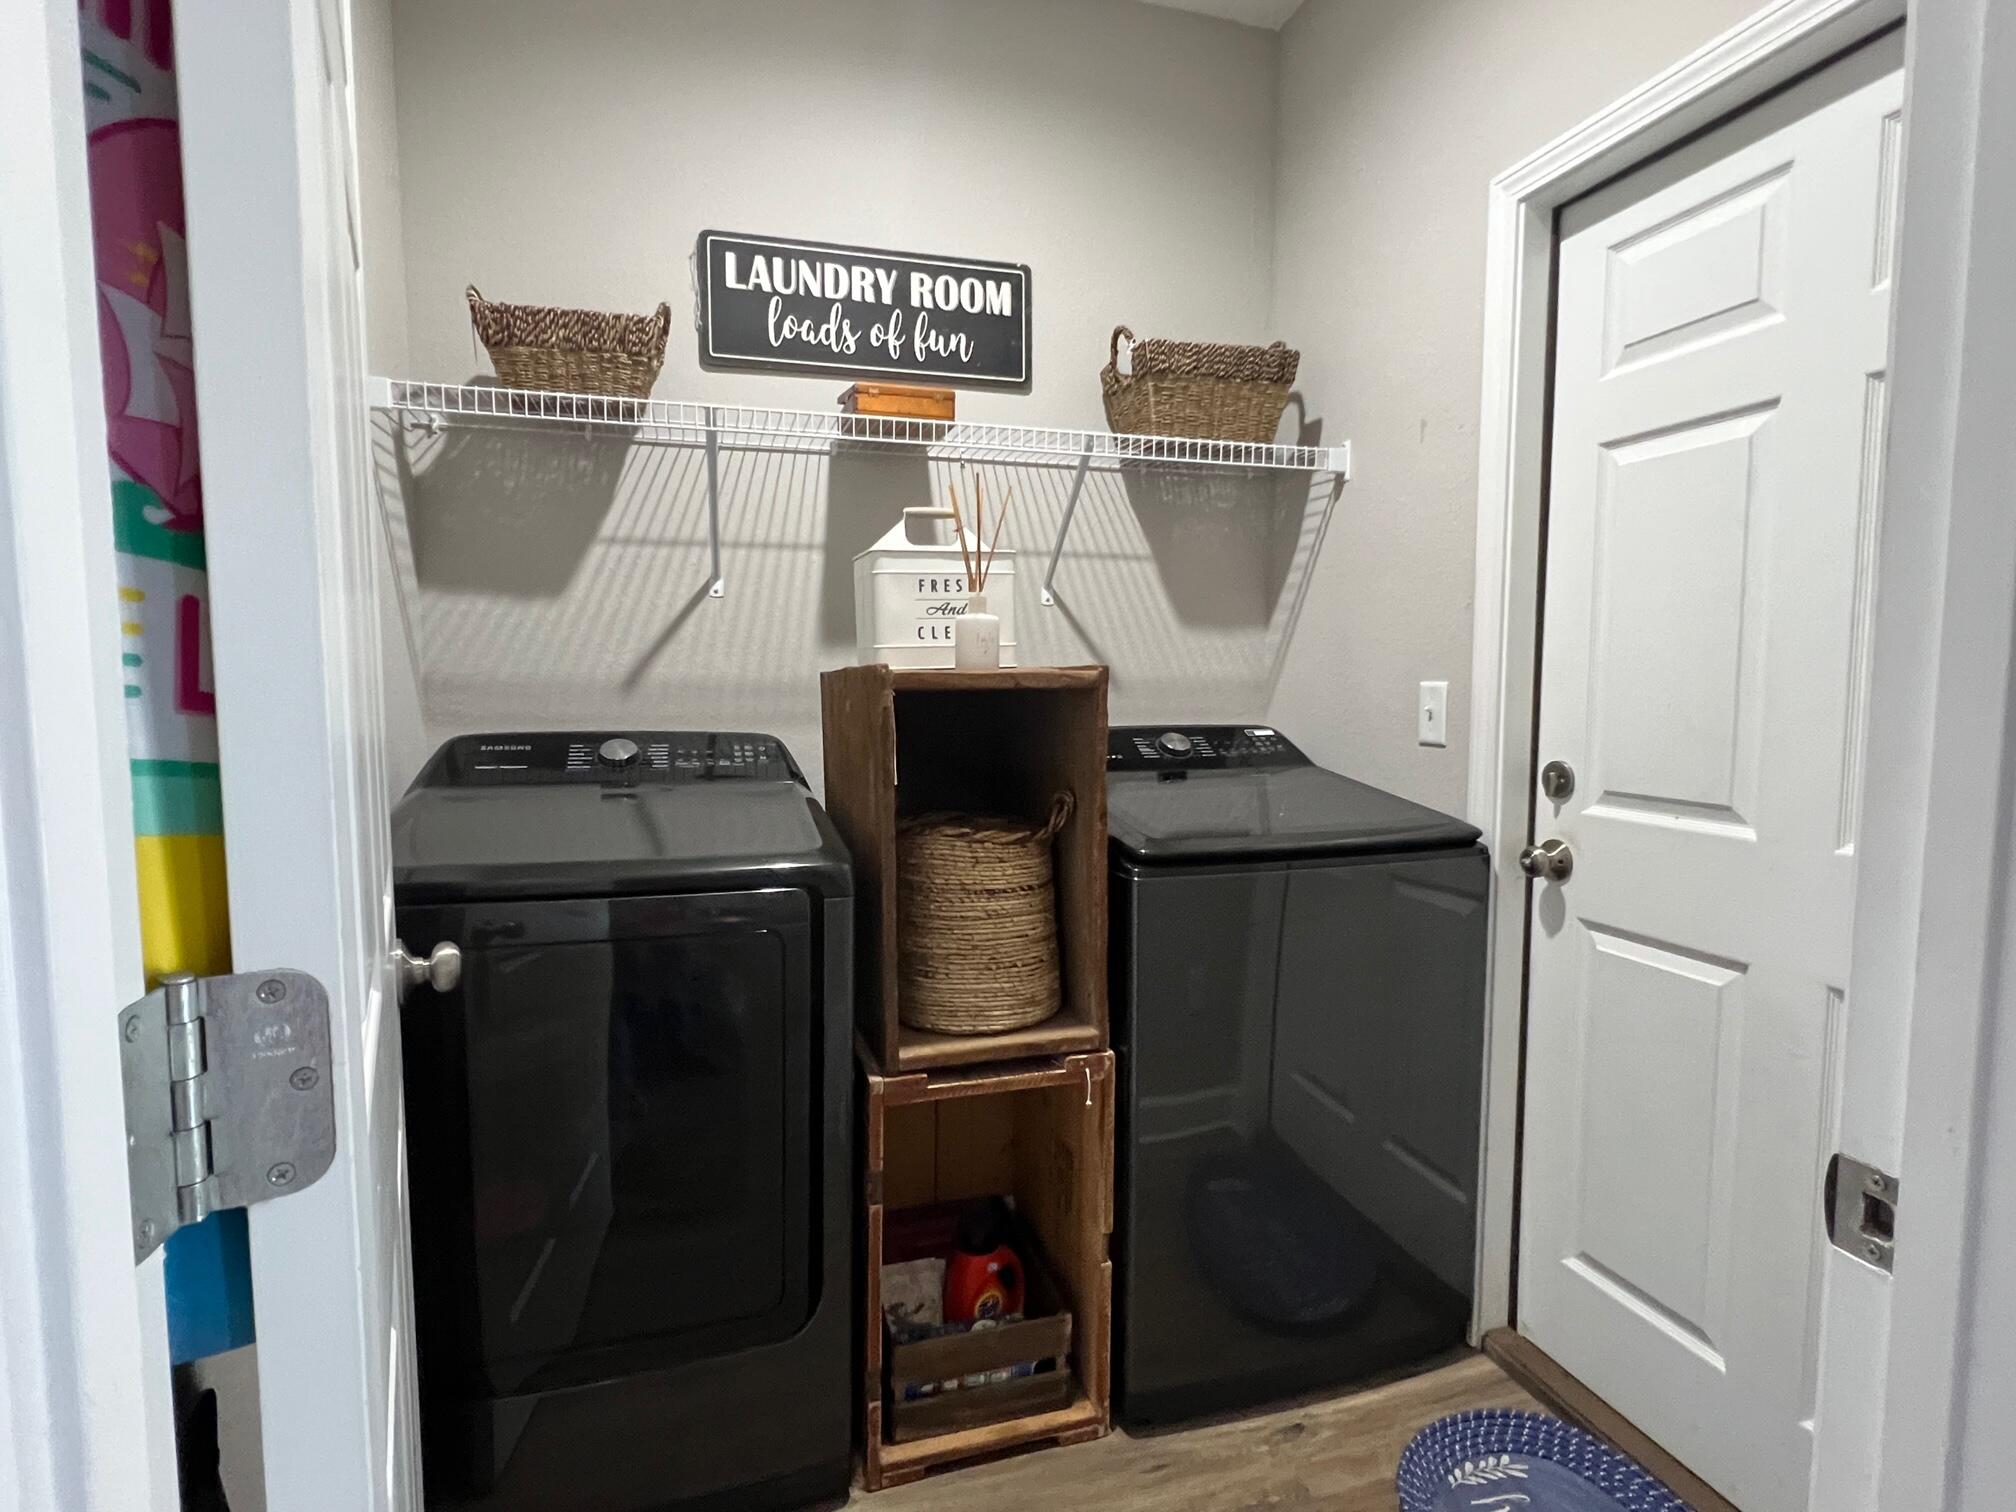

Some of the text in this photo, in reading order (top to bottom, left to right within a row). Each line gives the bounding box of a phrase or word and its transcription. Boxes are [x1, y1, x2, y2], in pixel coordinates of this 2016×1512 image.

[725, 251, 1012, 317] LAUNDRY ROOM
[768, 296, 974, 363] loads of fun
[918, 579, 963, 593] FRES
[926, 602, 968, 616] And
[917, 626, 951, 640] CLE
